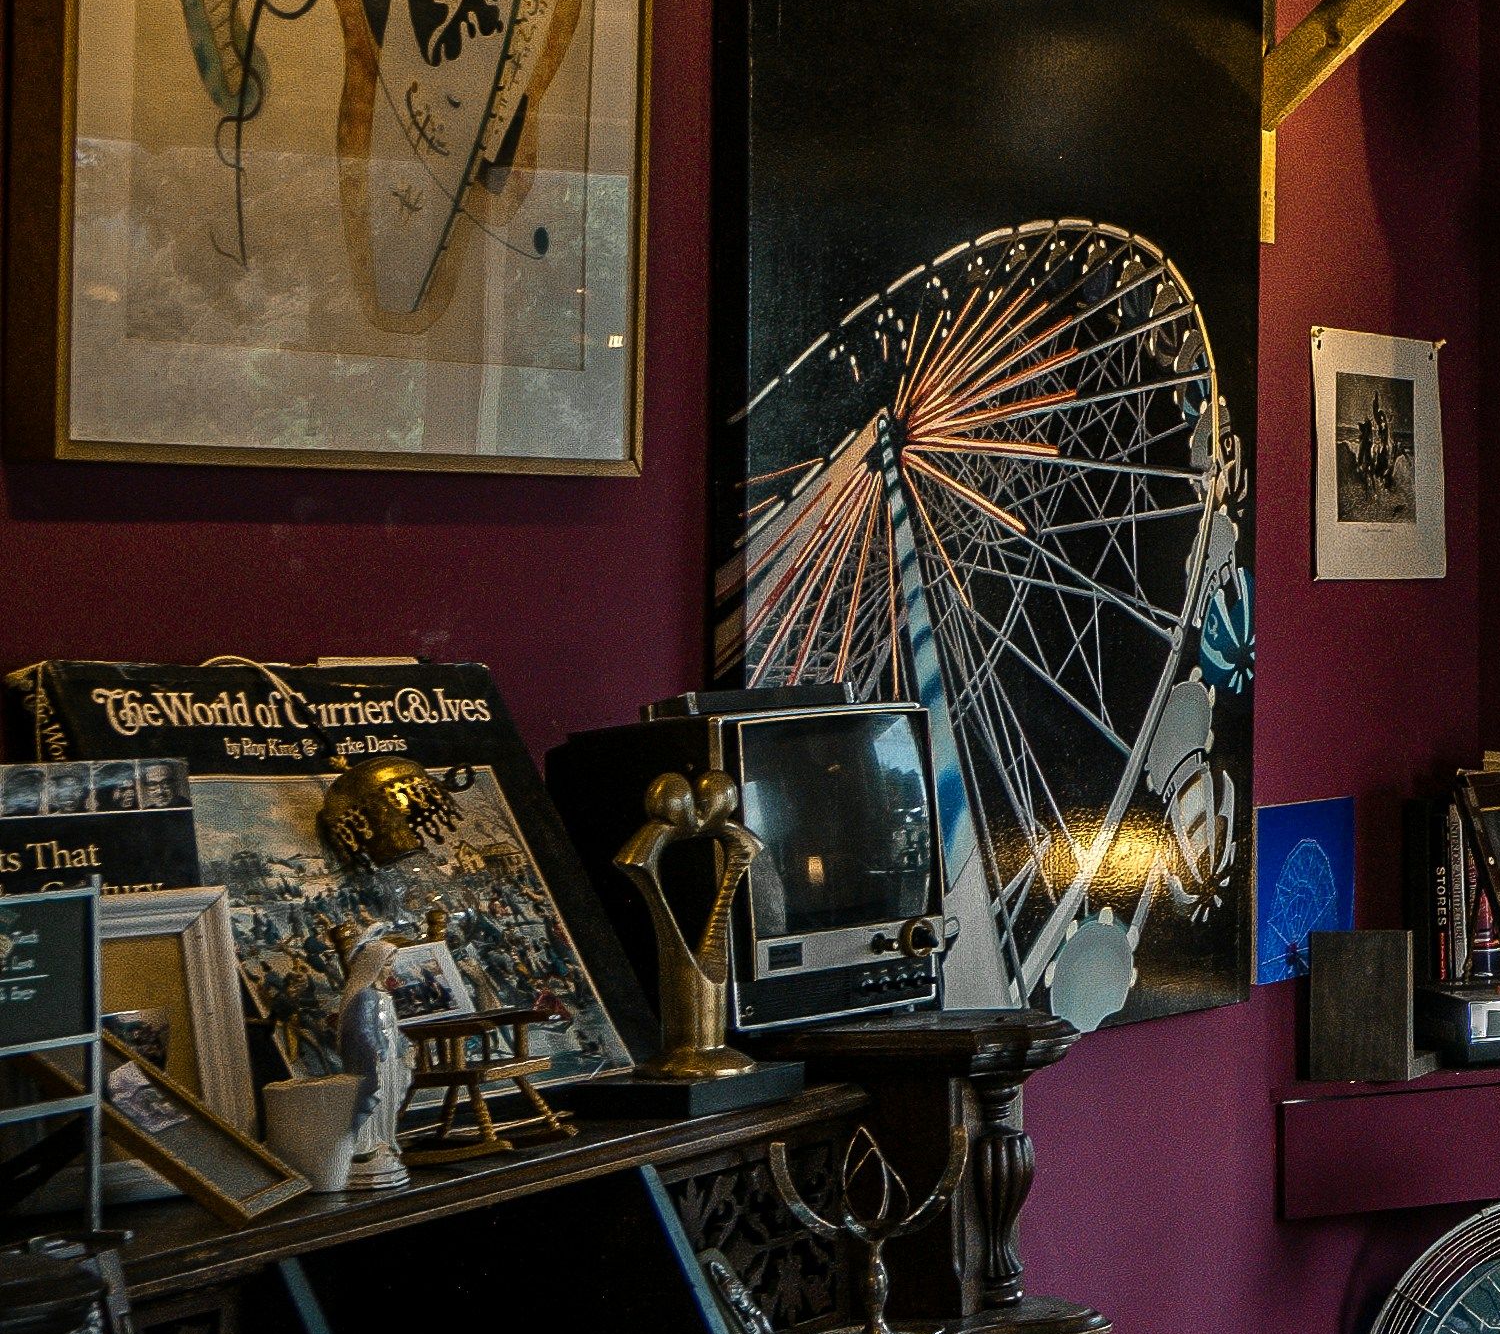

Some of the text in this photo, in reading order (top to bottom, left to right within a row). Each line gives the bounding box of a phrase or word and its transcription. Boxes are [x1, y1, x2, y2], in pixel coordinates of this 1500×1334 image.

[91, 688, 164, 736] The
[161, 692, 254, 728] World
[257, 690, 282, 728] of
[284, 691, 393, 729] Currier
[433, 688, 491, 724] Ives
[223, 737, 241, 759] by
[241, 737, 266, 760] Roy
[267, 738, 301, 760] King
[302, 739, 318, 756] &
[365, 735, 408, 753] Davis
[26, 840, 102, 870] That
[1436, 867, 1447, 926] STORES
